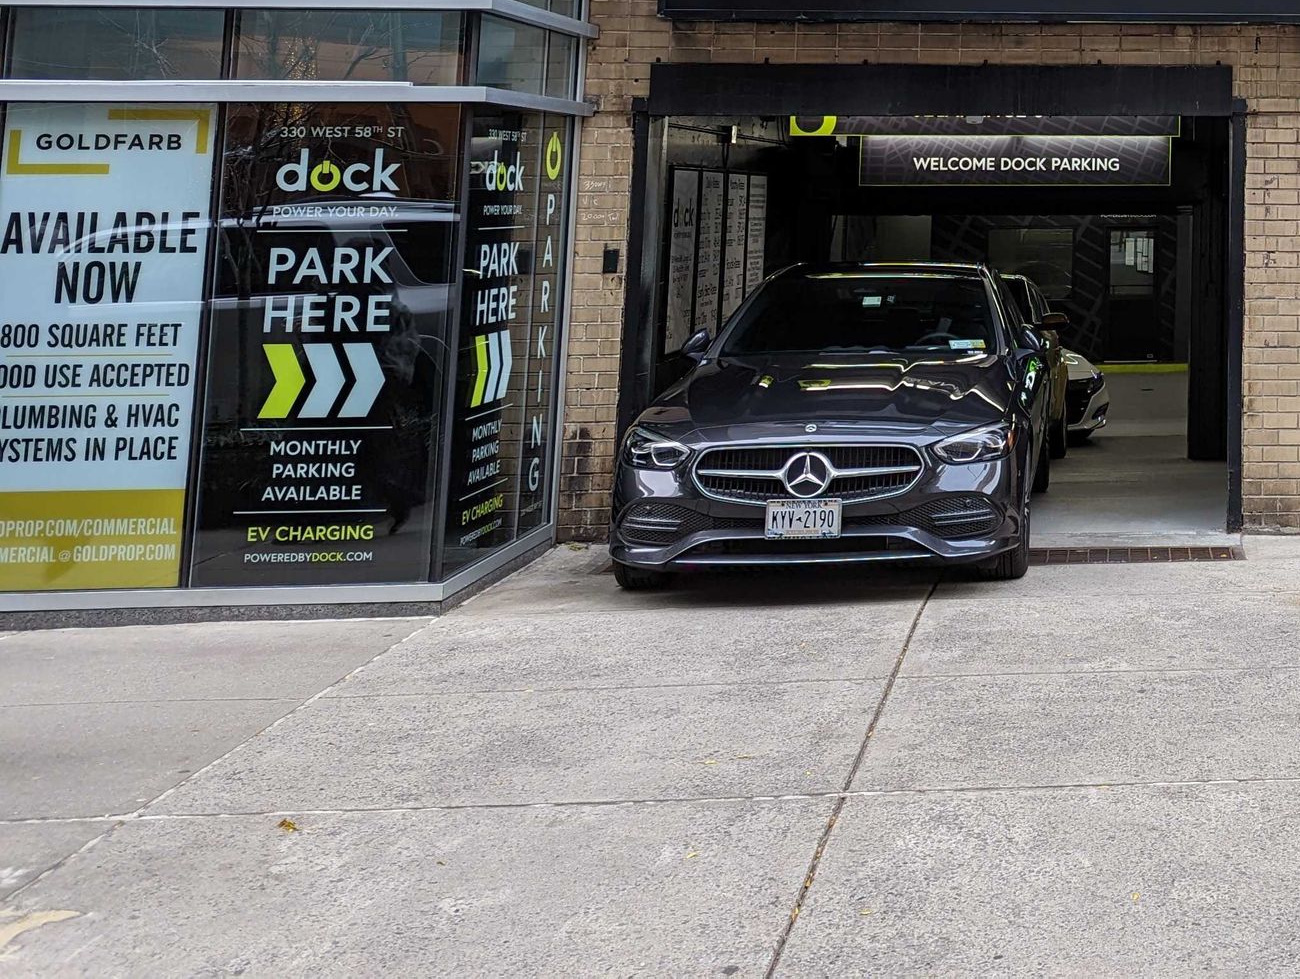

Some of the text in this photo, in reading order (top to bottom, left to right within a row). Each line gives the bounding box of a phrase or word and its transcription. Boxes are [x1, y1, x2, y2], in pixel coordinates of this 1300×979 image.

[36, 133, 182, 151] GOLDFARB
[280, 126, 306, 138] 330
[311, 126, 351, 138] WEST
[387, 126, 405, 138] ST
[275, 148, 402, 192] dock
[485, 149, 525, 191] dock
[913, 157, 1120, 172] WELCOME DOCK PARKING
[272, 206, 399, 218] POWER YOUR DAY.
[483, 205, 500, 216] POWER
[673, 197, 694, 228] dck
[0, 211, 200, 254] AVAILABLE
[267, 246, 394, 284] PARK
[479, 241, 520, 279] PARK
[54, 260, 142, 304] NOW
[262, 294, 393, 333] HERE
[475, 285, 518, 326] HERE
[0, 323, 182, 349] 800 SQUARE FEET
[528, 193, 556, 492] PARKING
[44, 364, 83, 388] USE
[88, 363, 190, 387] ACCEPTED
[0, 403, 180, 429] LUMBING & HVAC
[471, 418, 502, 442] MONTHLY
[84, 437, 106, 461] IN
[114, 436, 178, 461] PLACE
[269, 439, 362, 456] MONTHLY
[471, 440, 500, 463] PARKING
[272, 462, 355, 479] PARKING
[467, 459, 501, 486] AVAILABLE
[261, 485, 362, 501] AVAILABLE
[461, 509, 472, 526] EV
[471, 494, 503, 521] CHARGING
[247, 525, 374, 542] EV CHARGING
[243, 551, 373, 563] POWEREDBYDOCK.COM
